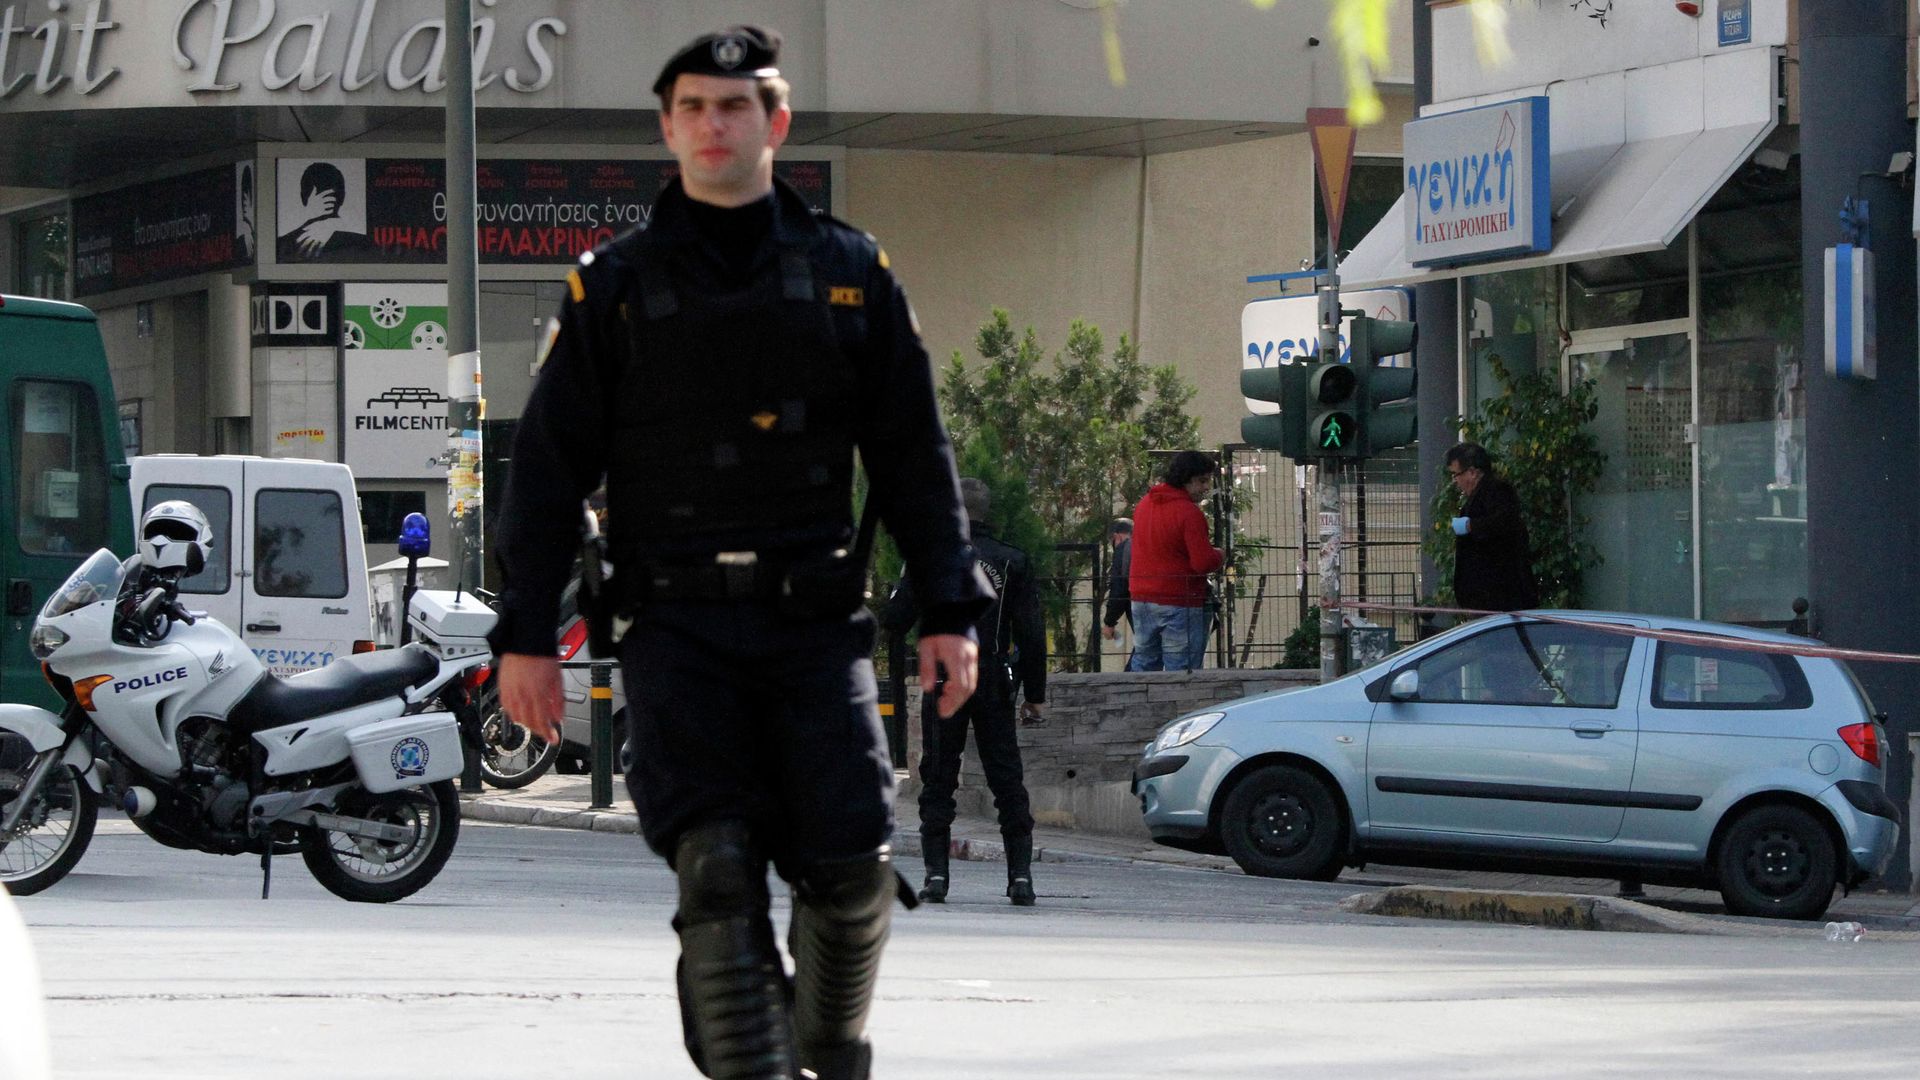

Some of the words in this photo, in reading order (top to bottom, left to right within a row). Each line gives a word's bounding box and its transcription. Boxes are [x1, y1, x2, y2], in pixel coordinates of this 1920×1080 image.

[171, 0, 567, 93] Palais
[432, 191, 448, 222] θ
[1423, 212, 1508, 244] ΤΑΧΥΔΡΟΜΙΚΗ
[113, 666, 188, 694] POLICE
